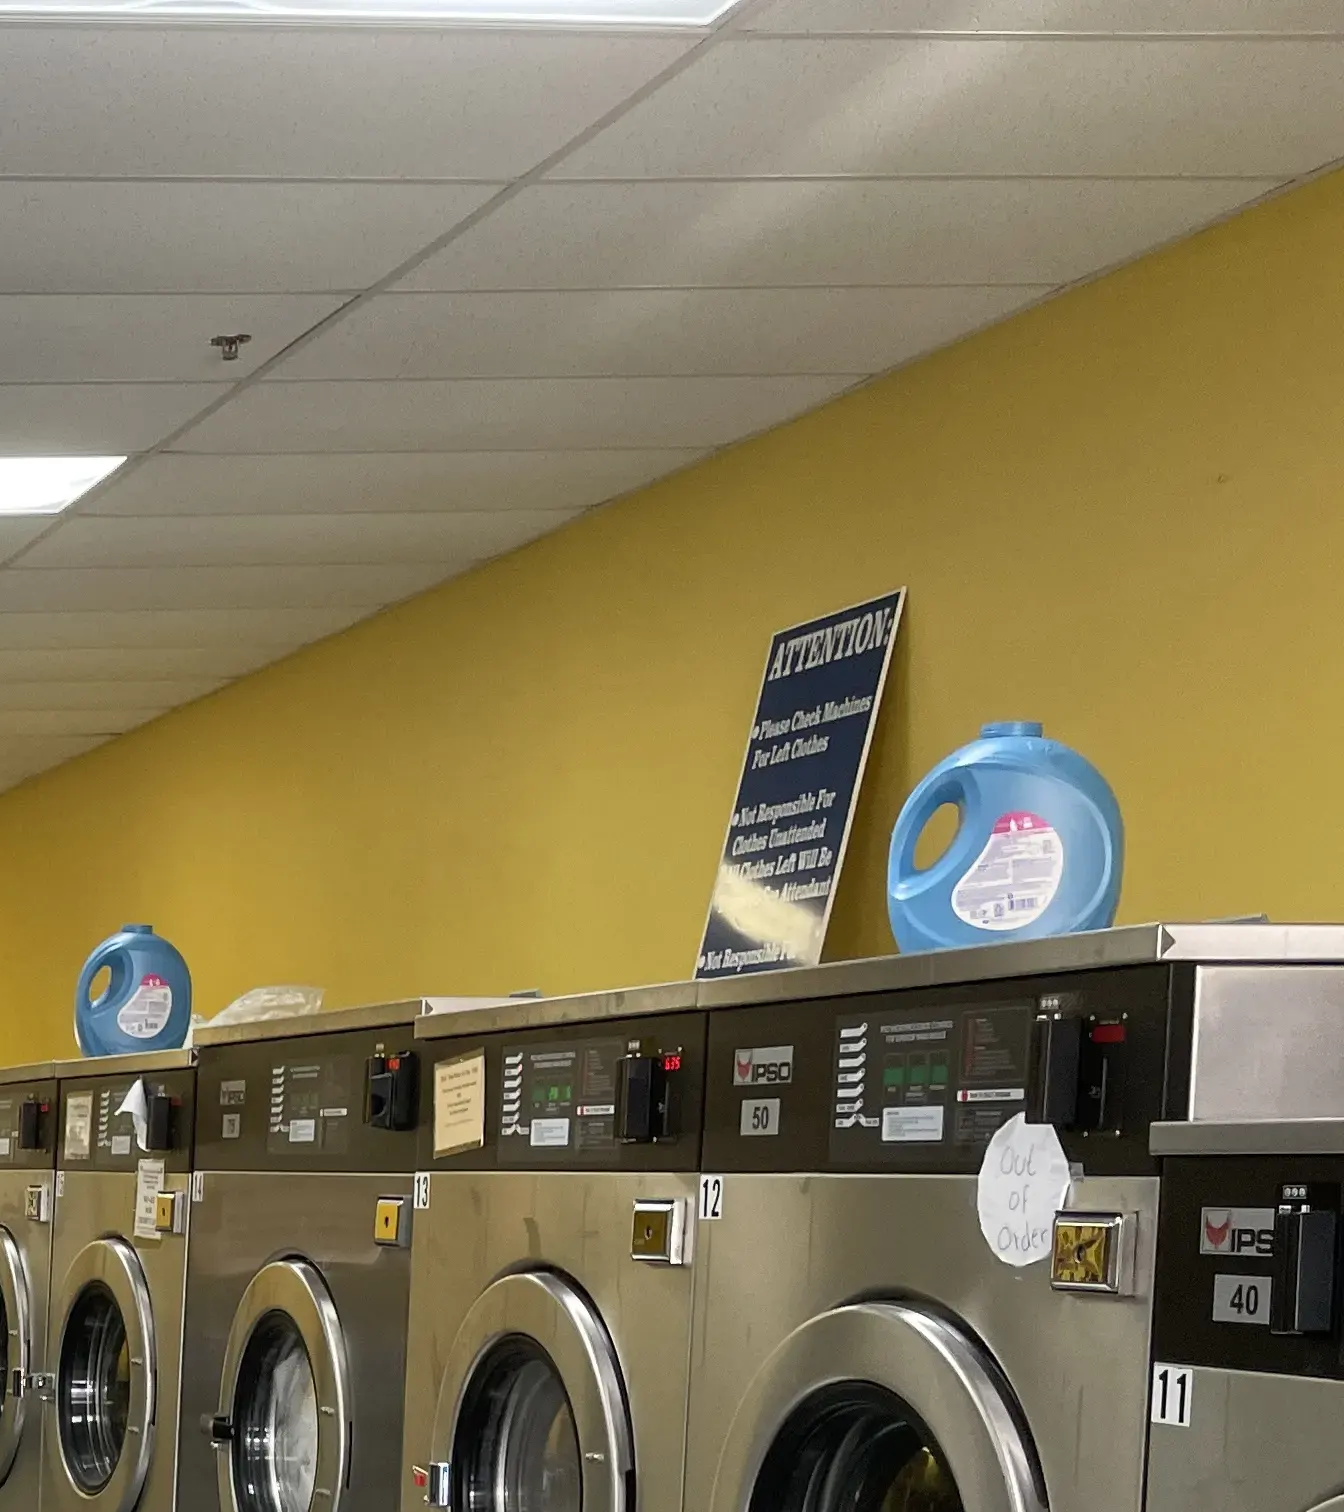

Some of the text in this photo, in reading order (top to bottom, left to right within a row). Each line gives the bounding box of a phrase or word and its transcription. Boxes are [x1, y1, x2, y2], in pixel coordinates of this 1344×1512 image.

[768, 607, 894, 681] ATTENTION:
[791, 707, 822, 731] Check
[822, 696, 873, 724] Machines
[751, 734, 830, 770] For Left Clothes
[740, 789, 836, 828] Not Responsible For
[732, 817, 827, 856] Clothes Unattended
[775, 853, 796, 875] Left
[797, 848, 819, 871] Will
[818, 846, 832, 867] Be
[779, 876, 831, 903] Attendant
[704, 948, 722, 971] Not
[722, 941, 779, 972] Responsible
[752, 1062, 790, 1083] IPSO
[752, 1106, 769, 1130] 50
[1000, 1143, 1036, 1176] Out
[416, 1175, 429, 1207] 13
[703, 1179, 720, 1217] 12
[1008, 1184, 1030, 1213] of
[998, 1220, 1049, 1251] Order
[1231, 1228, 1276, 1254] IPS
[1229, 1284, 1259, 1316] 40
[1158, 1369, 1187, 1424] 11
